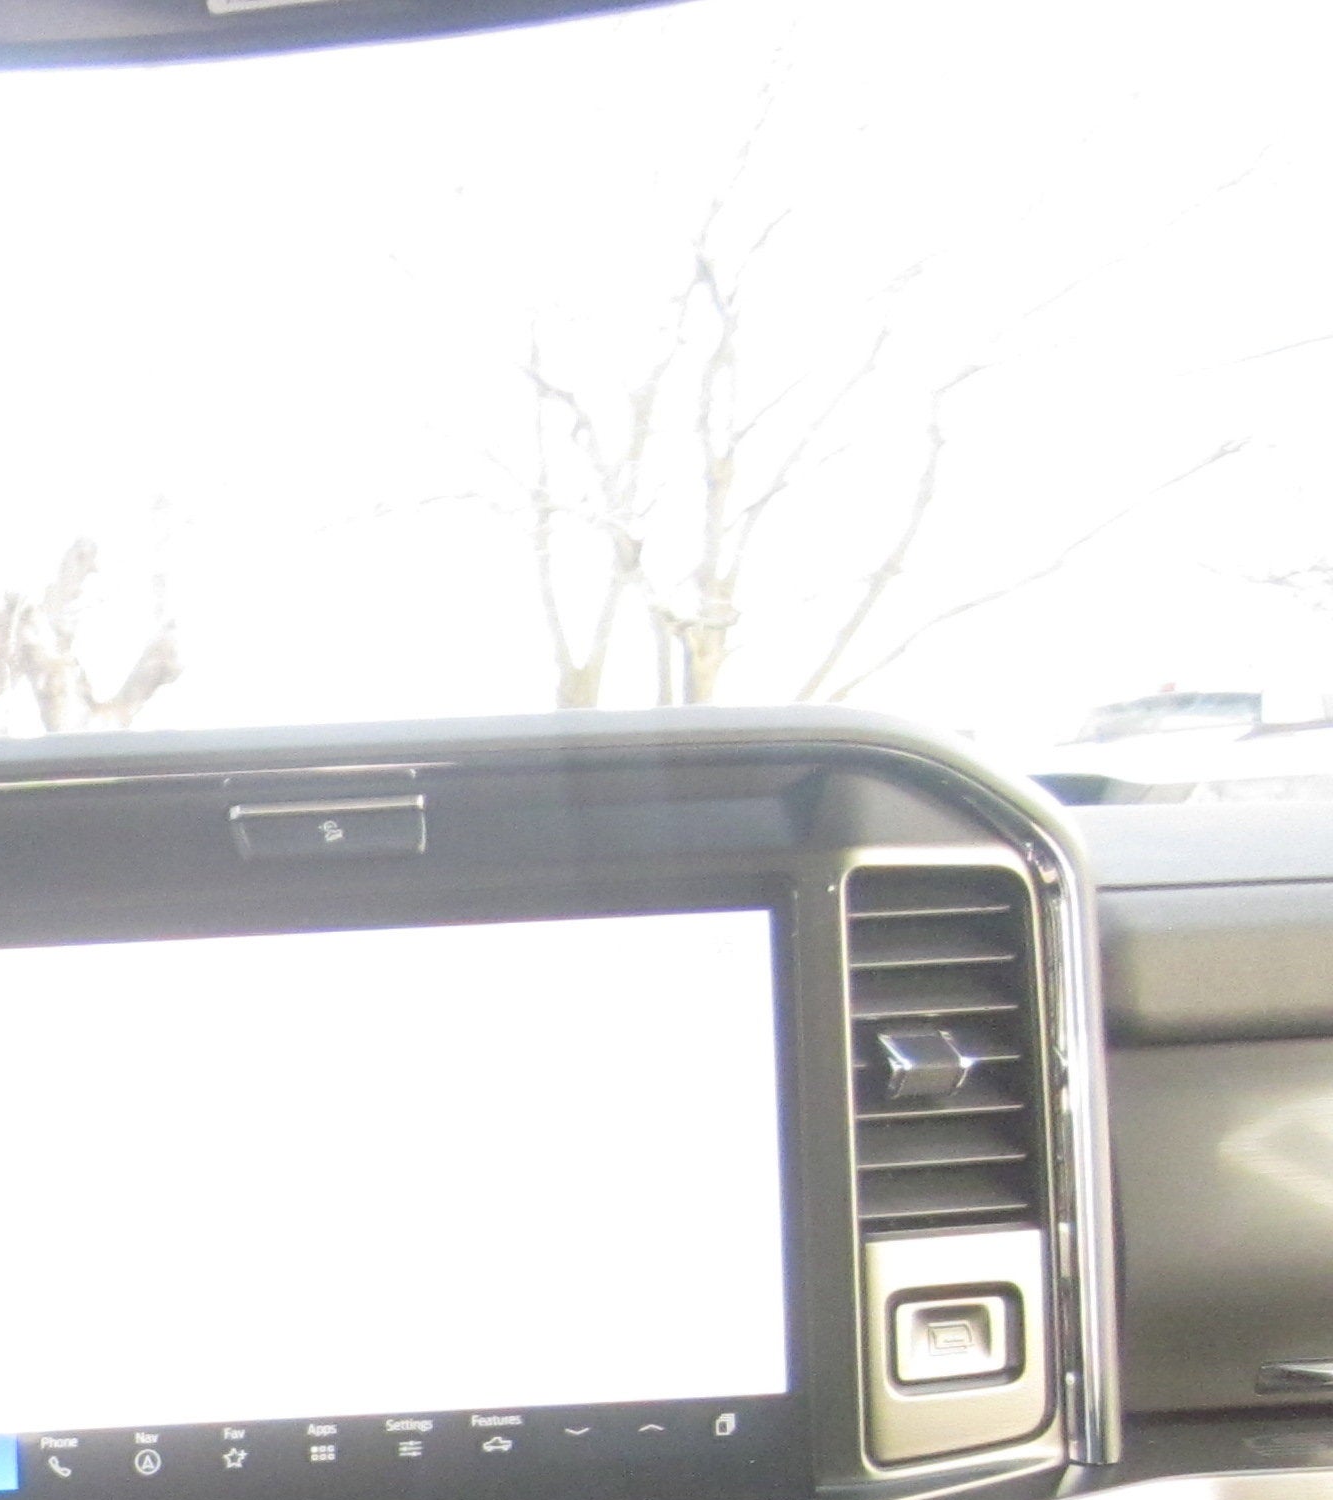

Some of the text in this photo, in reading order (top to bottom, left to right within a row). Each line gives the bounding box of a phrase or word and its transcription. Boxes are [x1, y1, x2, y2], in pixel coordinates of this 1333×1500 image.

[385, 1417, 434, 1433] Settings
[470, 1413, 525, 1429] Features
[223, 1427, 246, 1441] Fav
[306, 1422, 338, 1437] Apps
[40, 1436, 79, 1451] Phone
[134, 1431, 160, 1445] Nav
